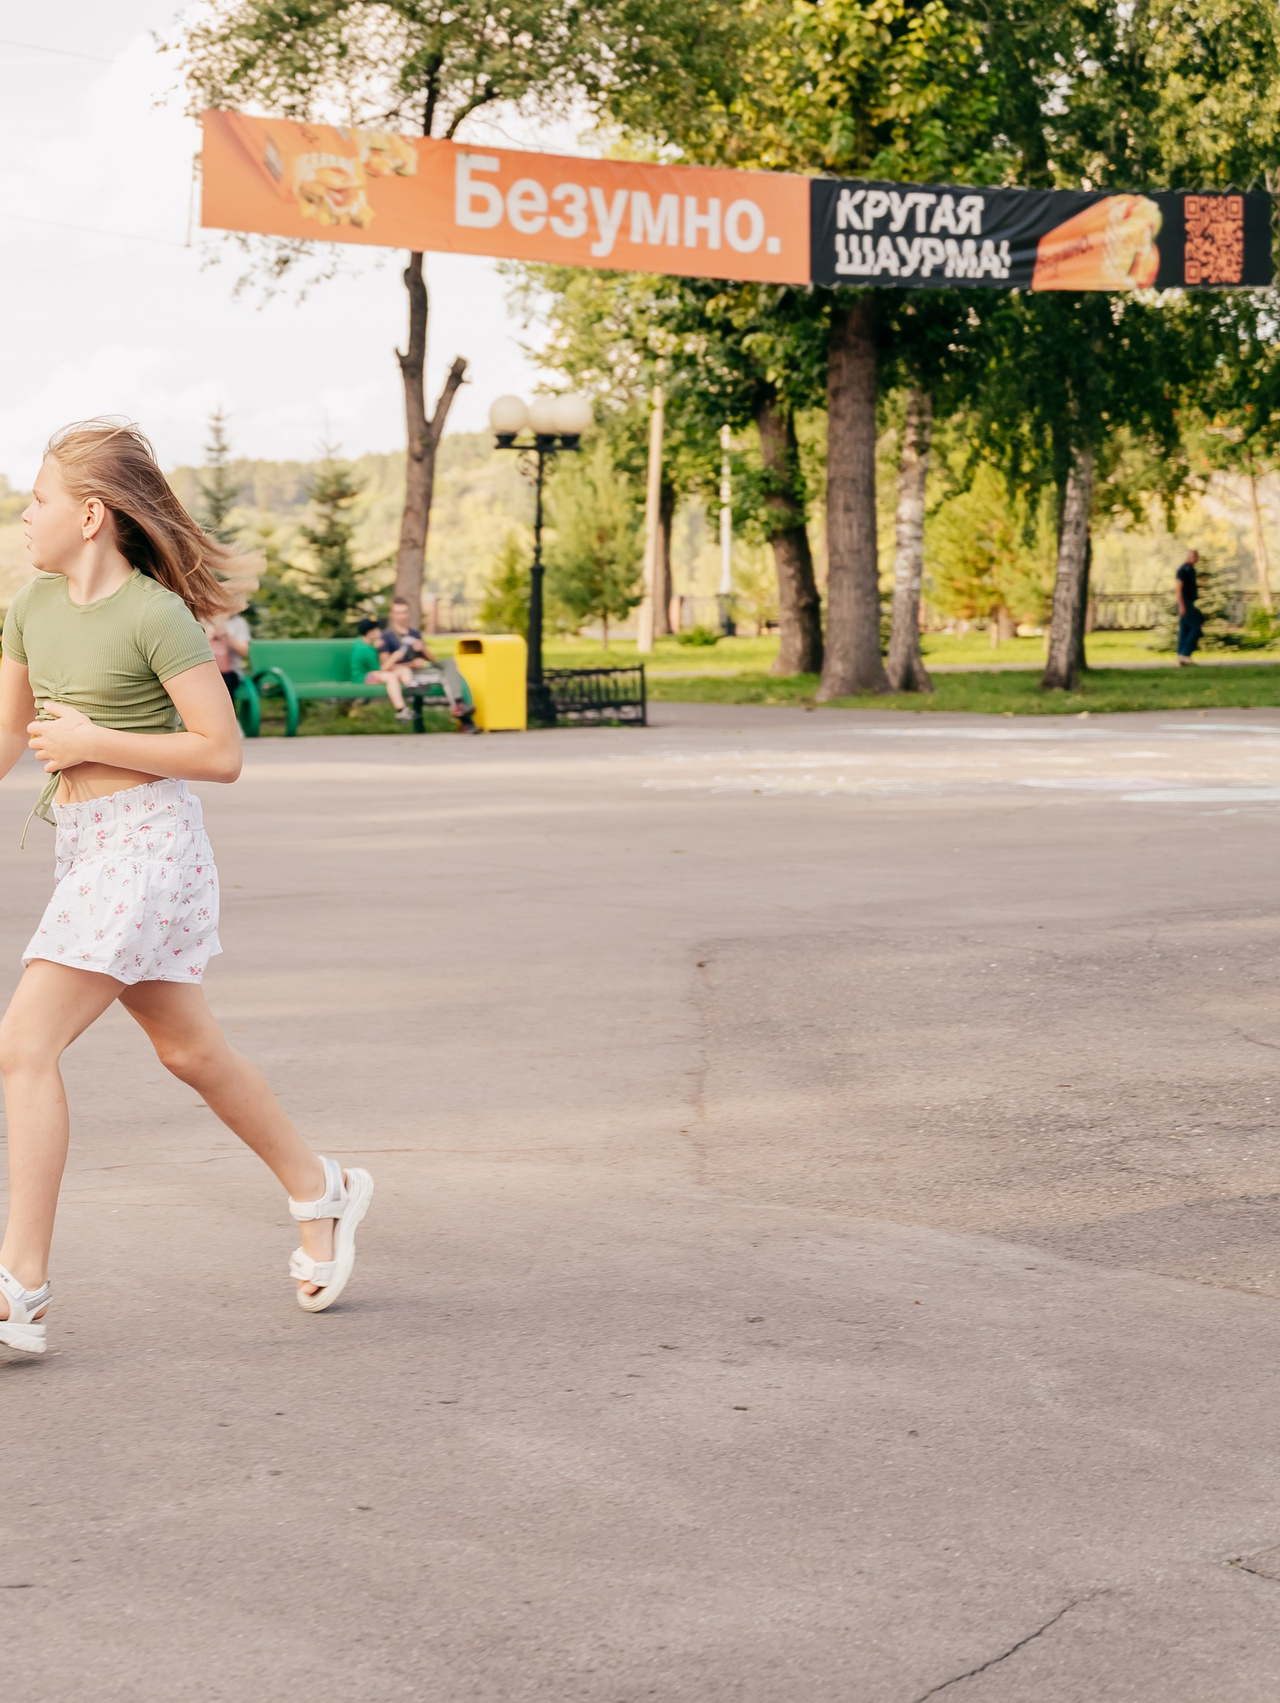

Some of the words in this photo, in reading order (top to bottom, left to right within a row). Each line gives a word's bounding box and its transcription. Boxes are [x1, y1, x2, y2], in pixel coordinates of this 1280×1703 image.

[455, 153, 781, 257] Безумно.
[836, 188, 985, 236] КРУТАЯ
[834, 233, 1012, 279] ШАУРМА!
